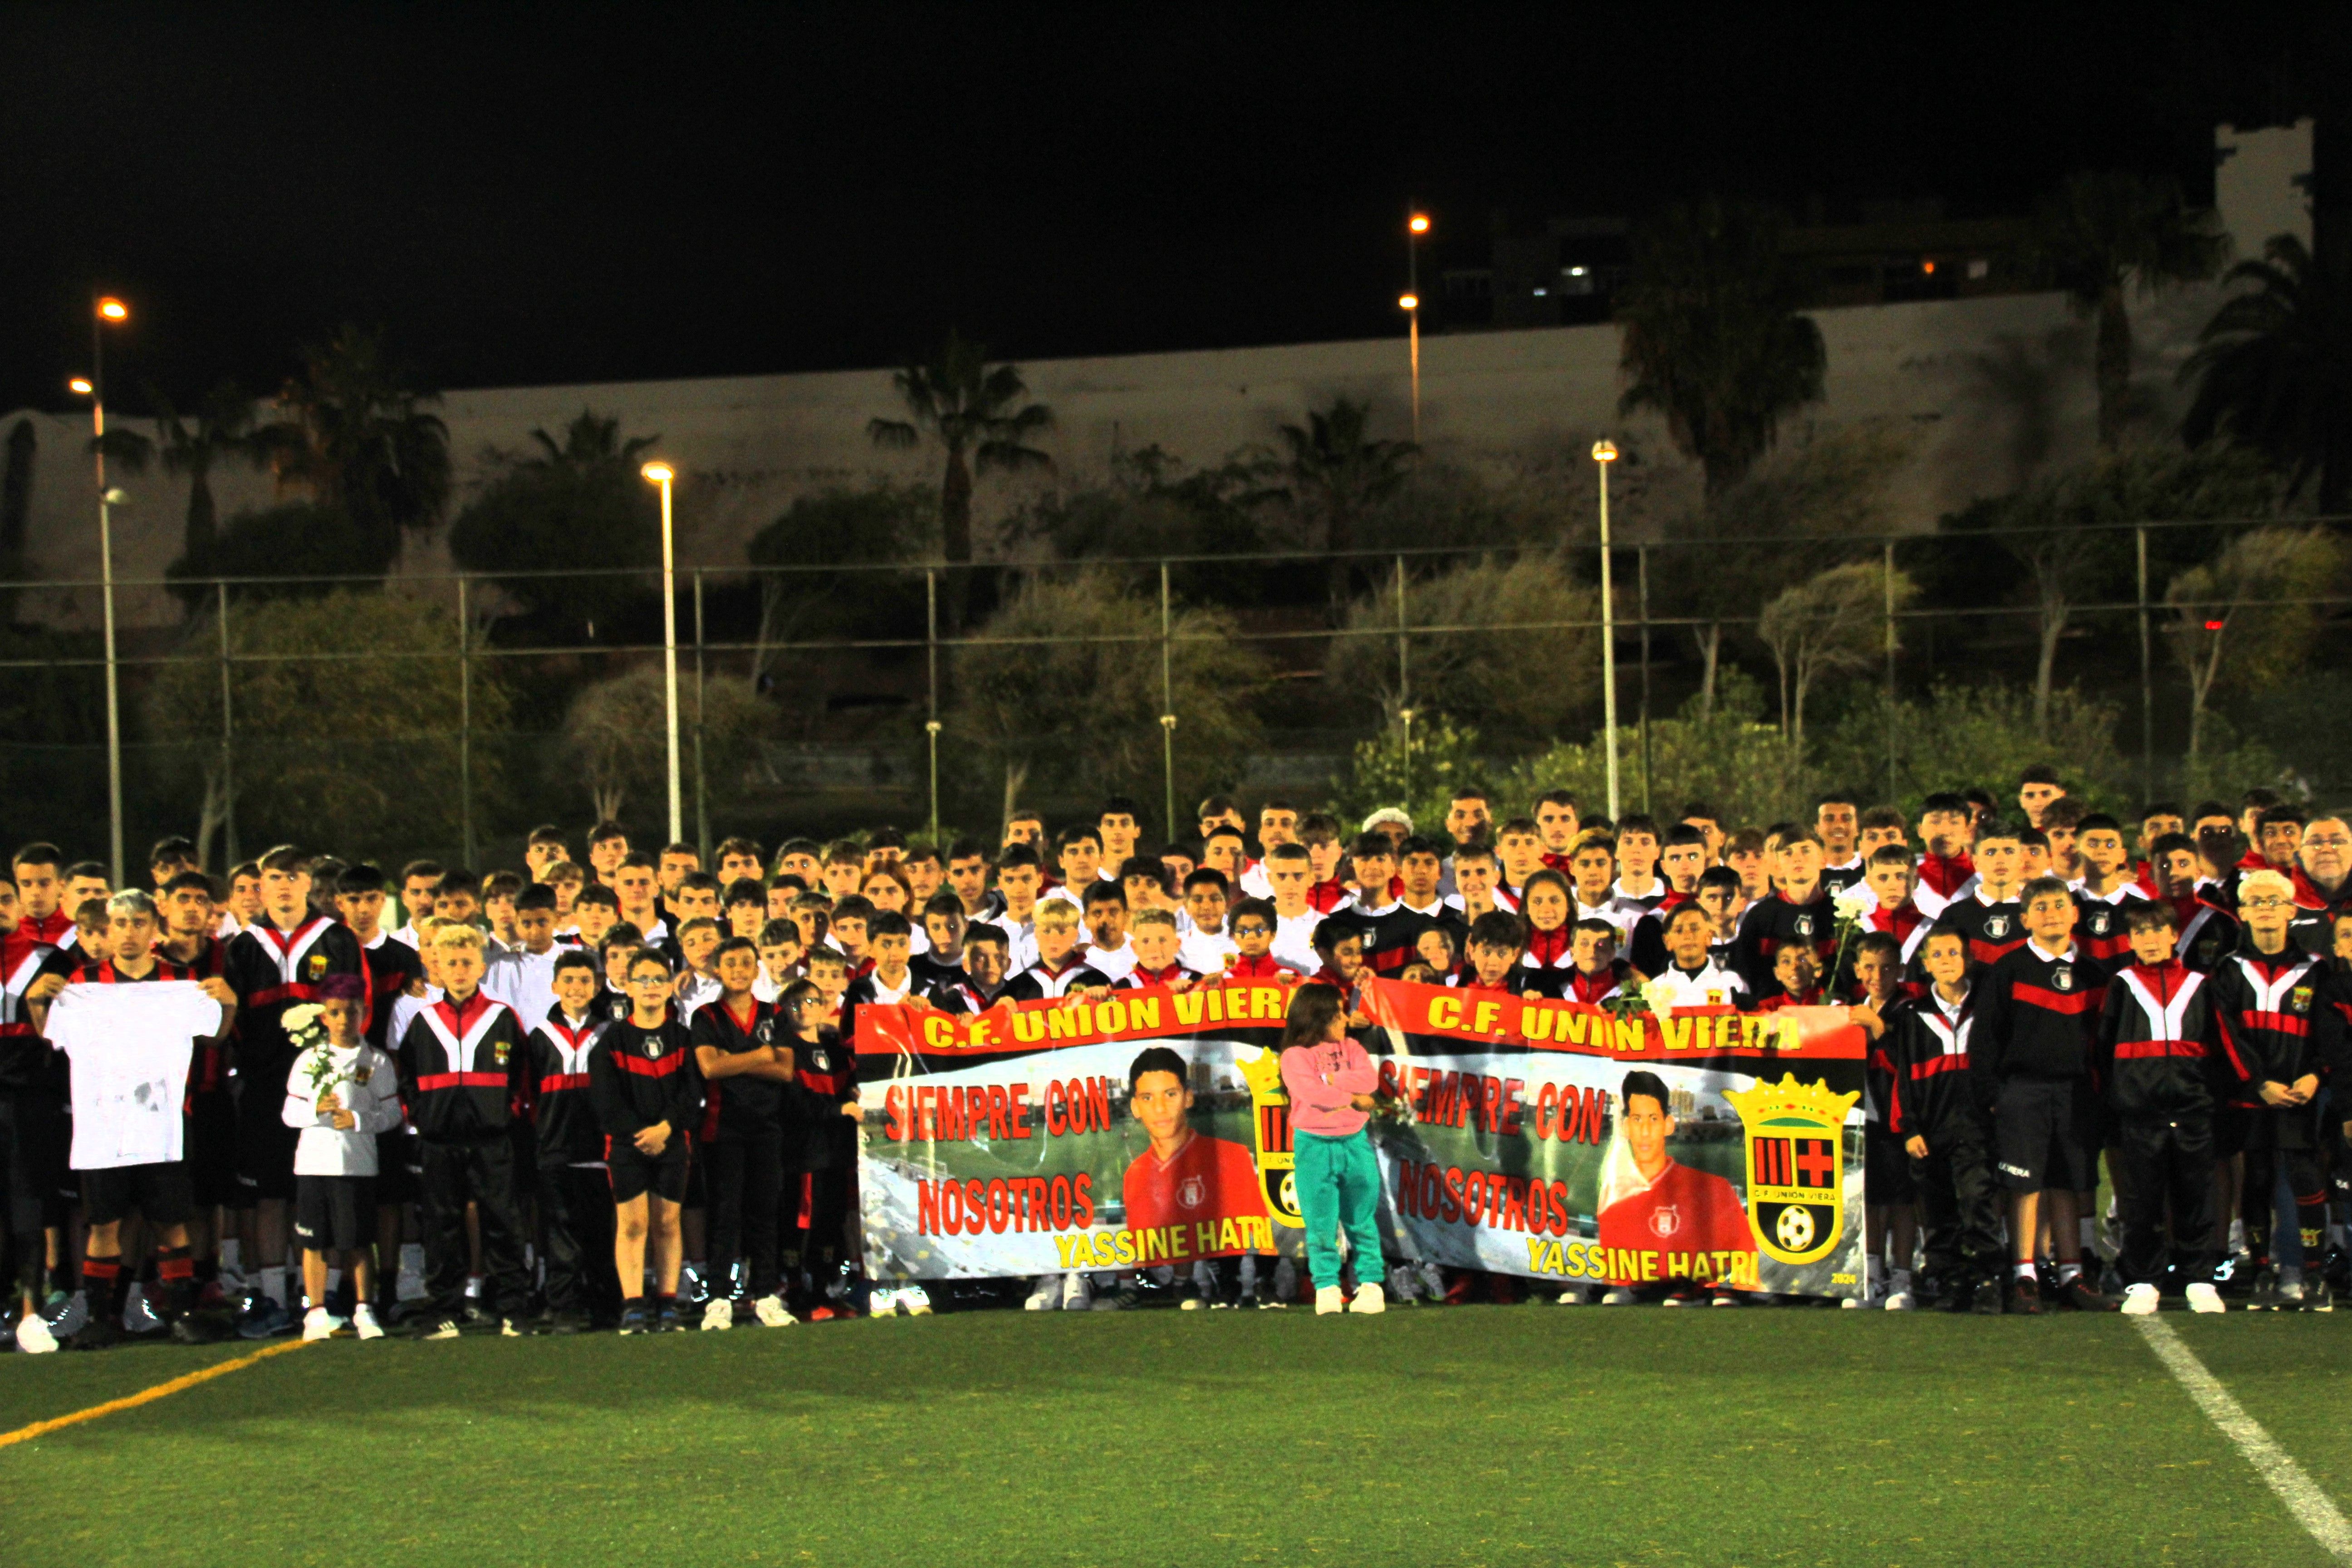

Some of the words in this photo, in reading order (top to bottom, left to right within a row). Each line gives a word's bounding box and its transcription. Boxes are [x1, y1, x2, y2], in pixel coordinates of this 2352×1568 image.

[924, 1016, 1001, 1049] C.F.
[1428, 995, 1506, 1035] C.F.
[1659, 1015, 1802, 1050] VIERA
[885, 1083, 1032, 1141] SIEMPRE
[1046, 1076, 1111, 1136] CON
[1378, 1060, 1524, 1135] SIEMPRE
[1536, 1082, 1606, 1145] CON
[918, 1173, 1093, 1236] NOSOTROS
[1398, 1159, 1568, 1236] NOSOTROS
[1054, 1225, 1189, 1269] YASSINE
[1198, 1215, 1274, 1254] HATRI
[1526, 1237, 1660, 1282] YASSINE
[1667, 1250, 1759, 1286] HATRI
[1831, 1273, 1857, 1284] 2024
